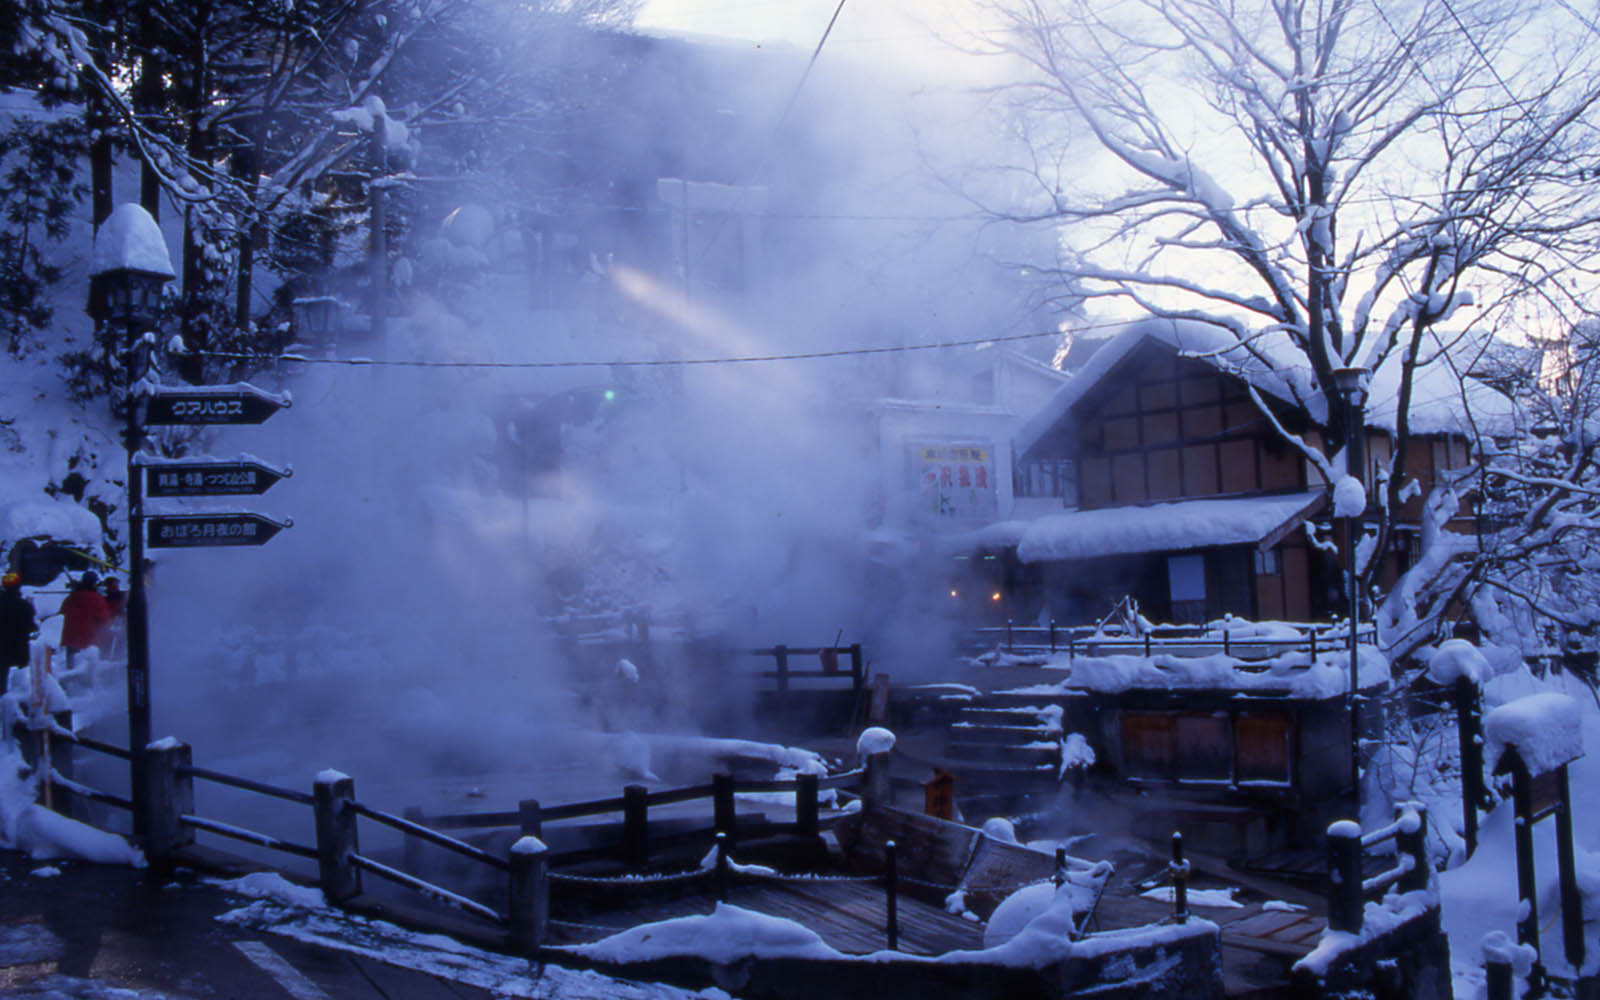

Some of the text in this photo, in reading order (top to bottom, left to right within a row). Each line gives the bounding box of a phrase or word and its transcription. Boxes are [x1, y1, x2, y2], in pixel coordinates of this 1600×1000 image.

[172, 401, 243, 415] クアハウス
[160, 522, 256, 538] おぼろ月夜の館
